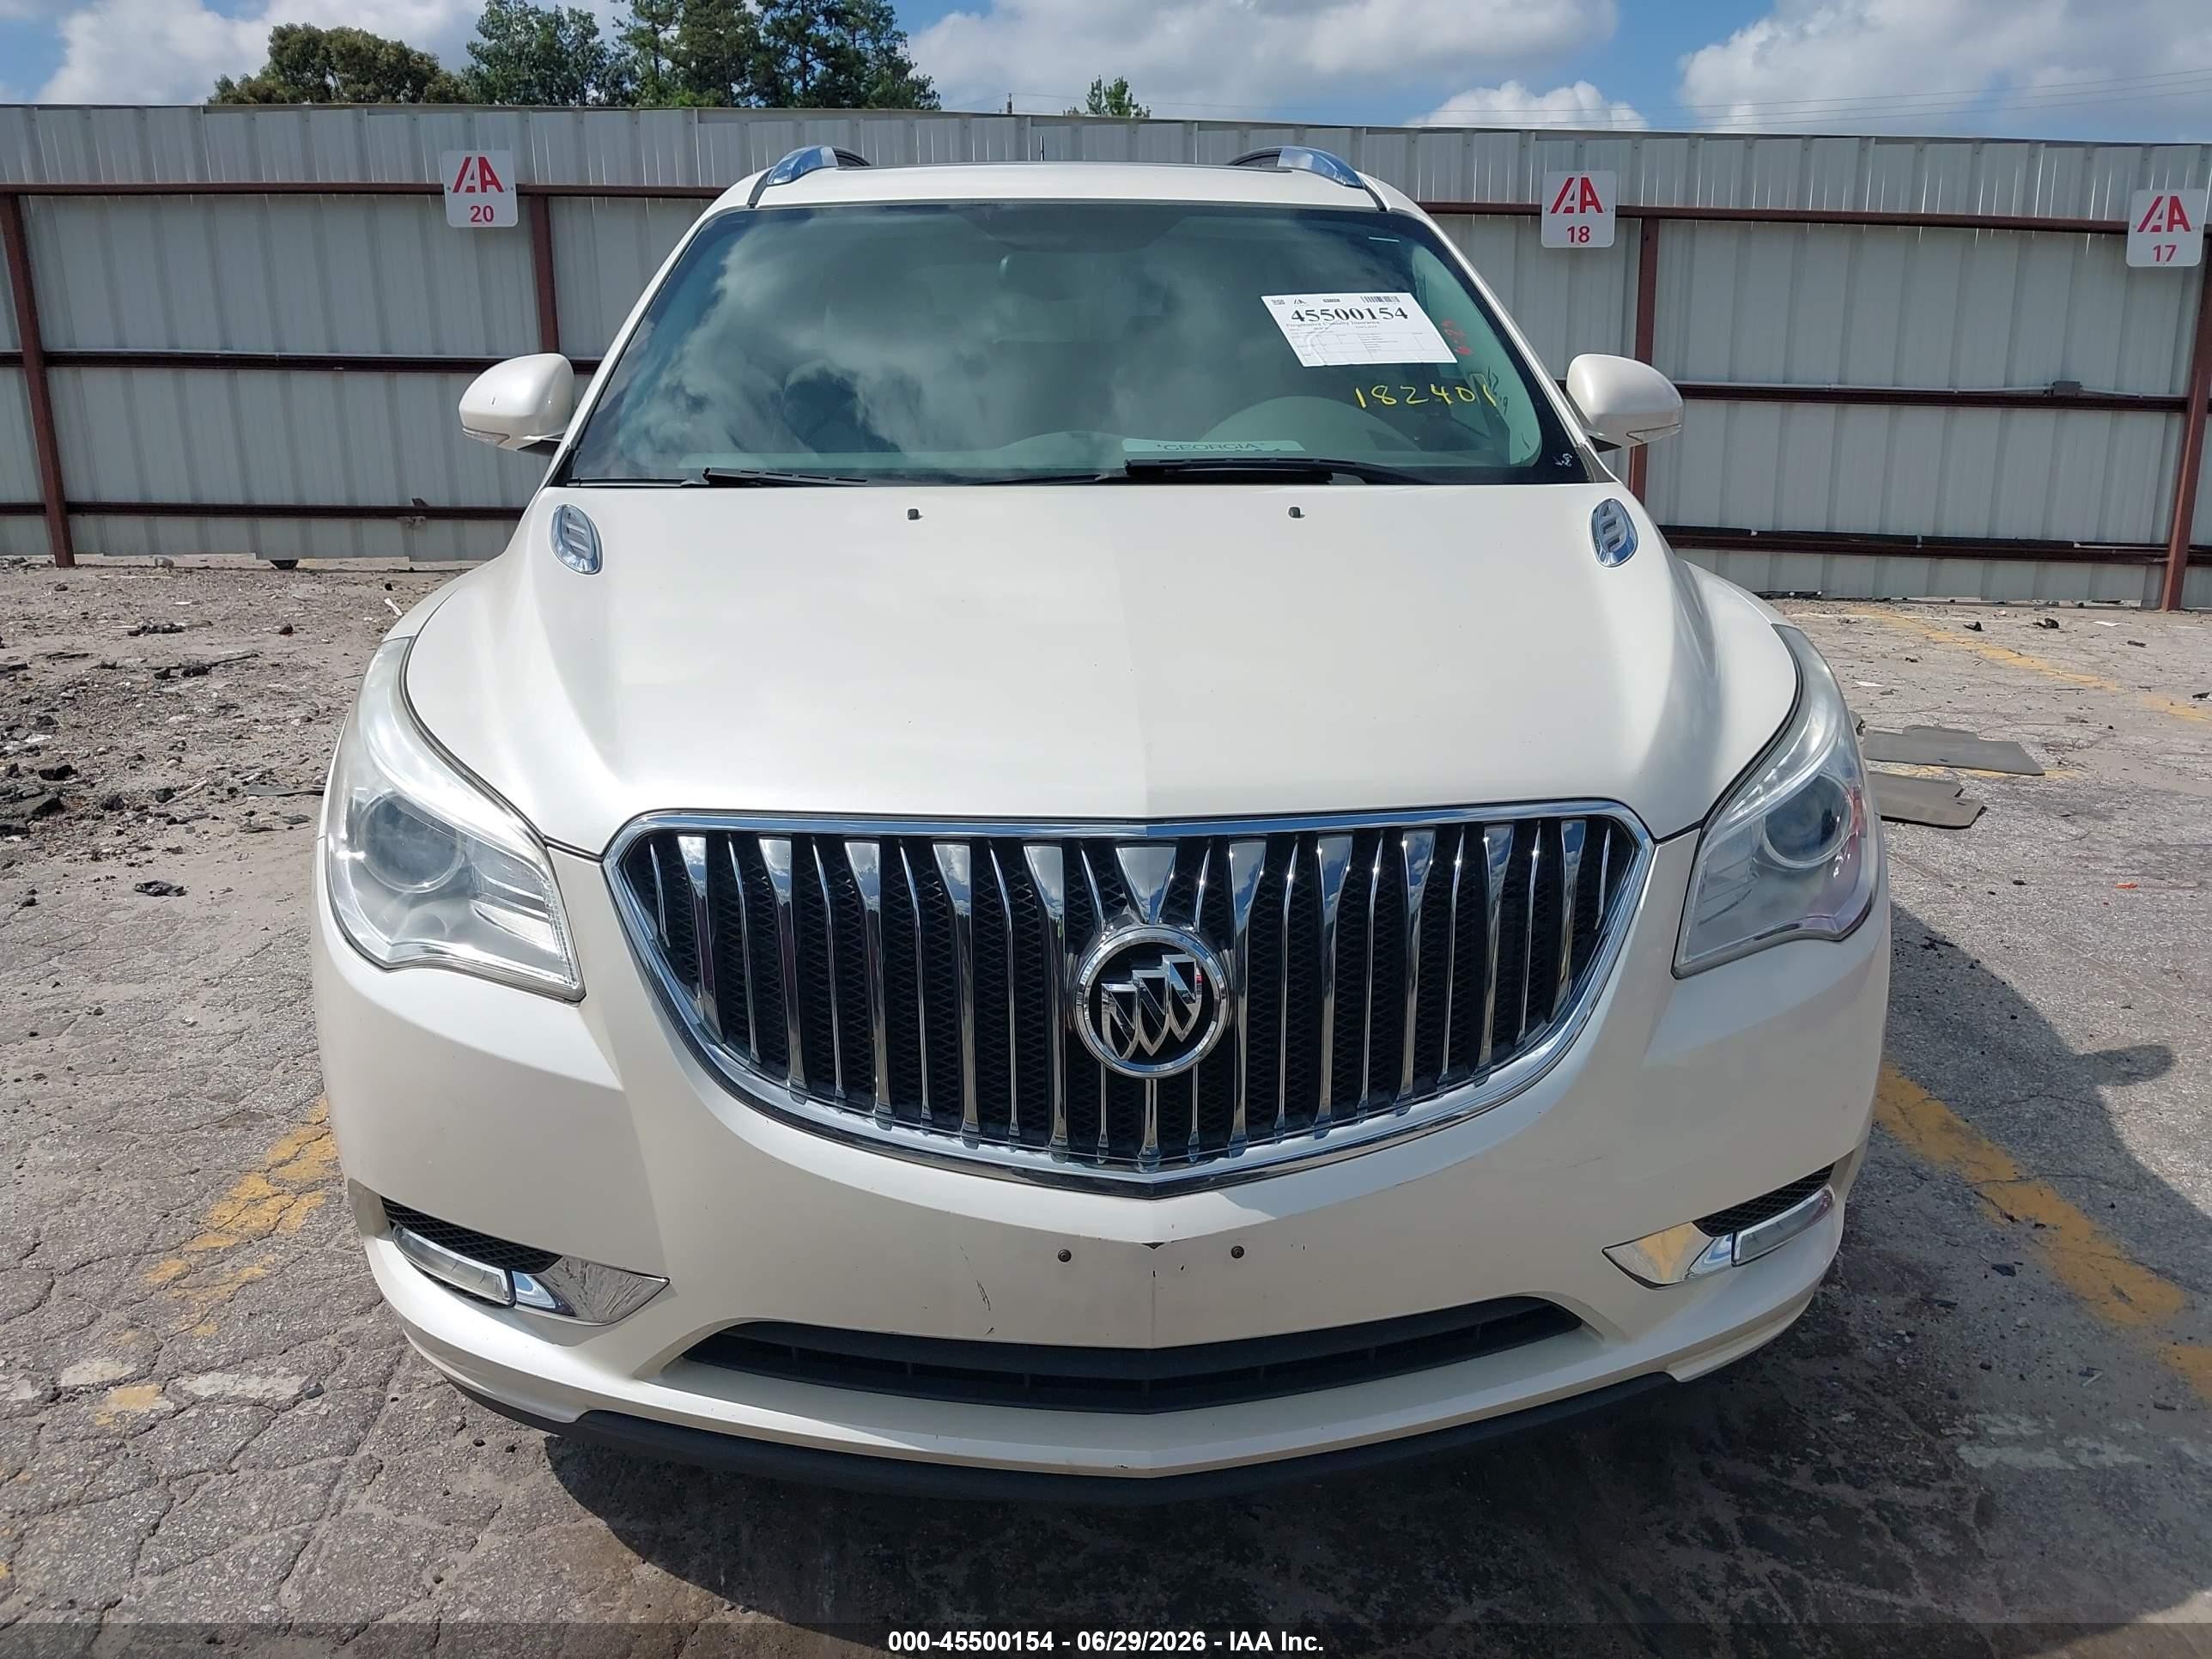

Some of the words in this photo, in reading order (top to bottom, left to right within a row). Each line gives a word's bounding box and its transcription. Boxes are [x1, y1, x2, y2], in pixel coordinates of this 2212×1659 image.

[470, 204, 495, 223] 20
[1566, 225, 1590, 244] 18
[2152, 244, 2178, 263] 17
[1291, 307, 1409, 322] 45500154
